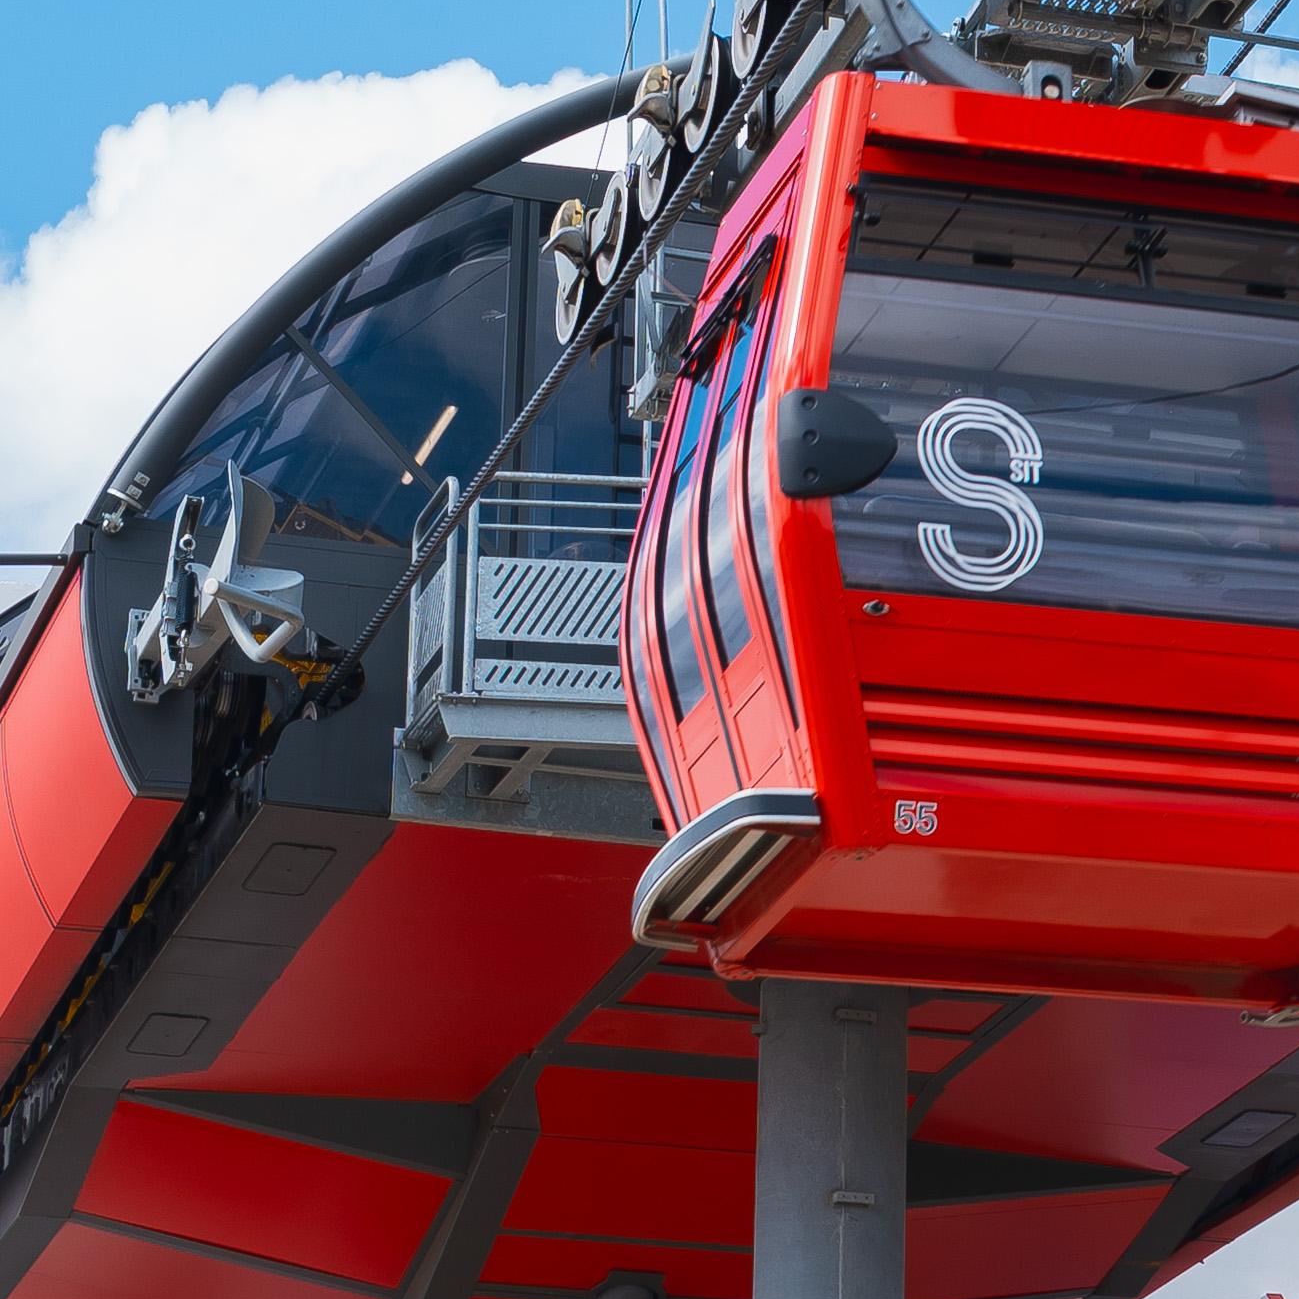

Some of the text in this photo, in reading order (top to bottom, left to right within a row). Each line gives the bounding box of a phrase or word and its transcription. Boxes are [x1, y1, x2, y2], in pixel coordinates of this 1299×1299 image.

[1009, 459, 1044, 485] SIT
[917, 397, 1044, 592] S
[894, 799, 938, 836] 55
